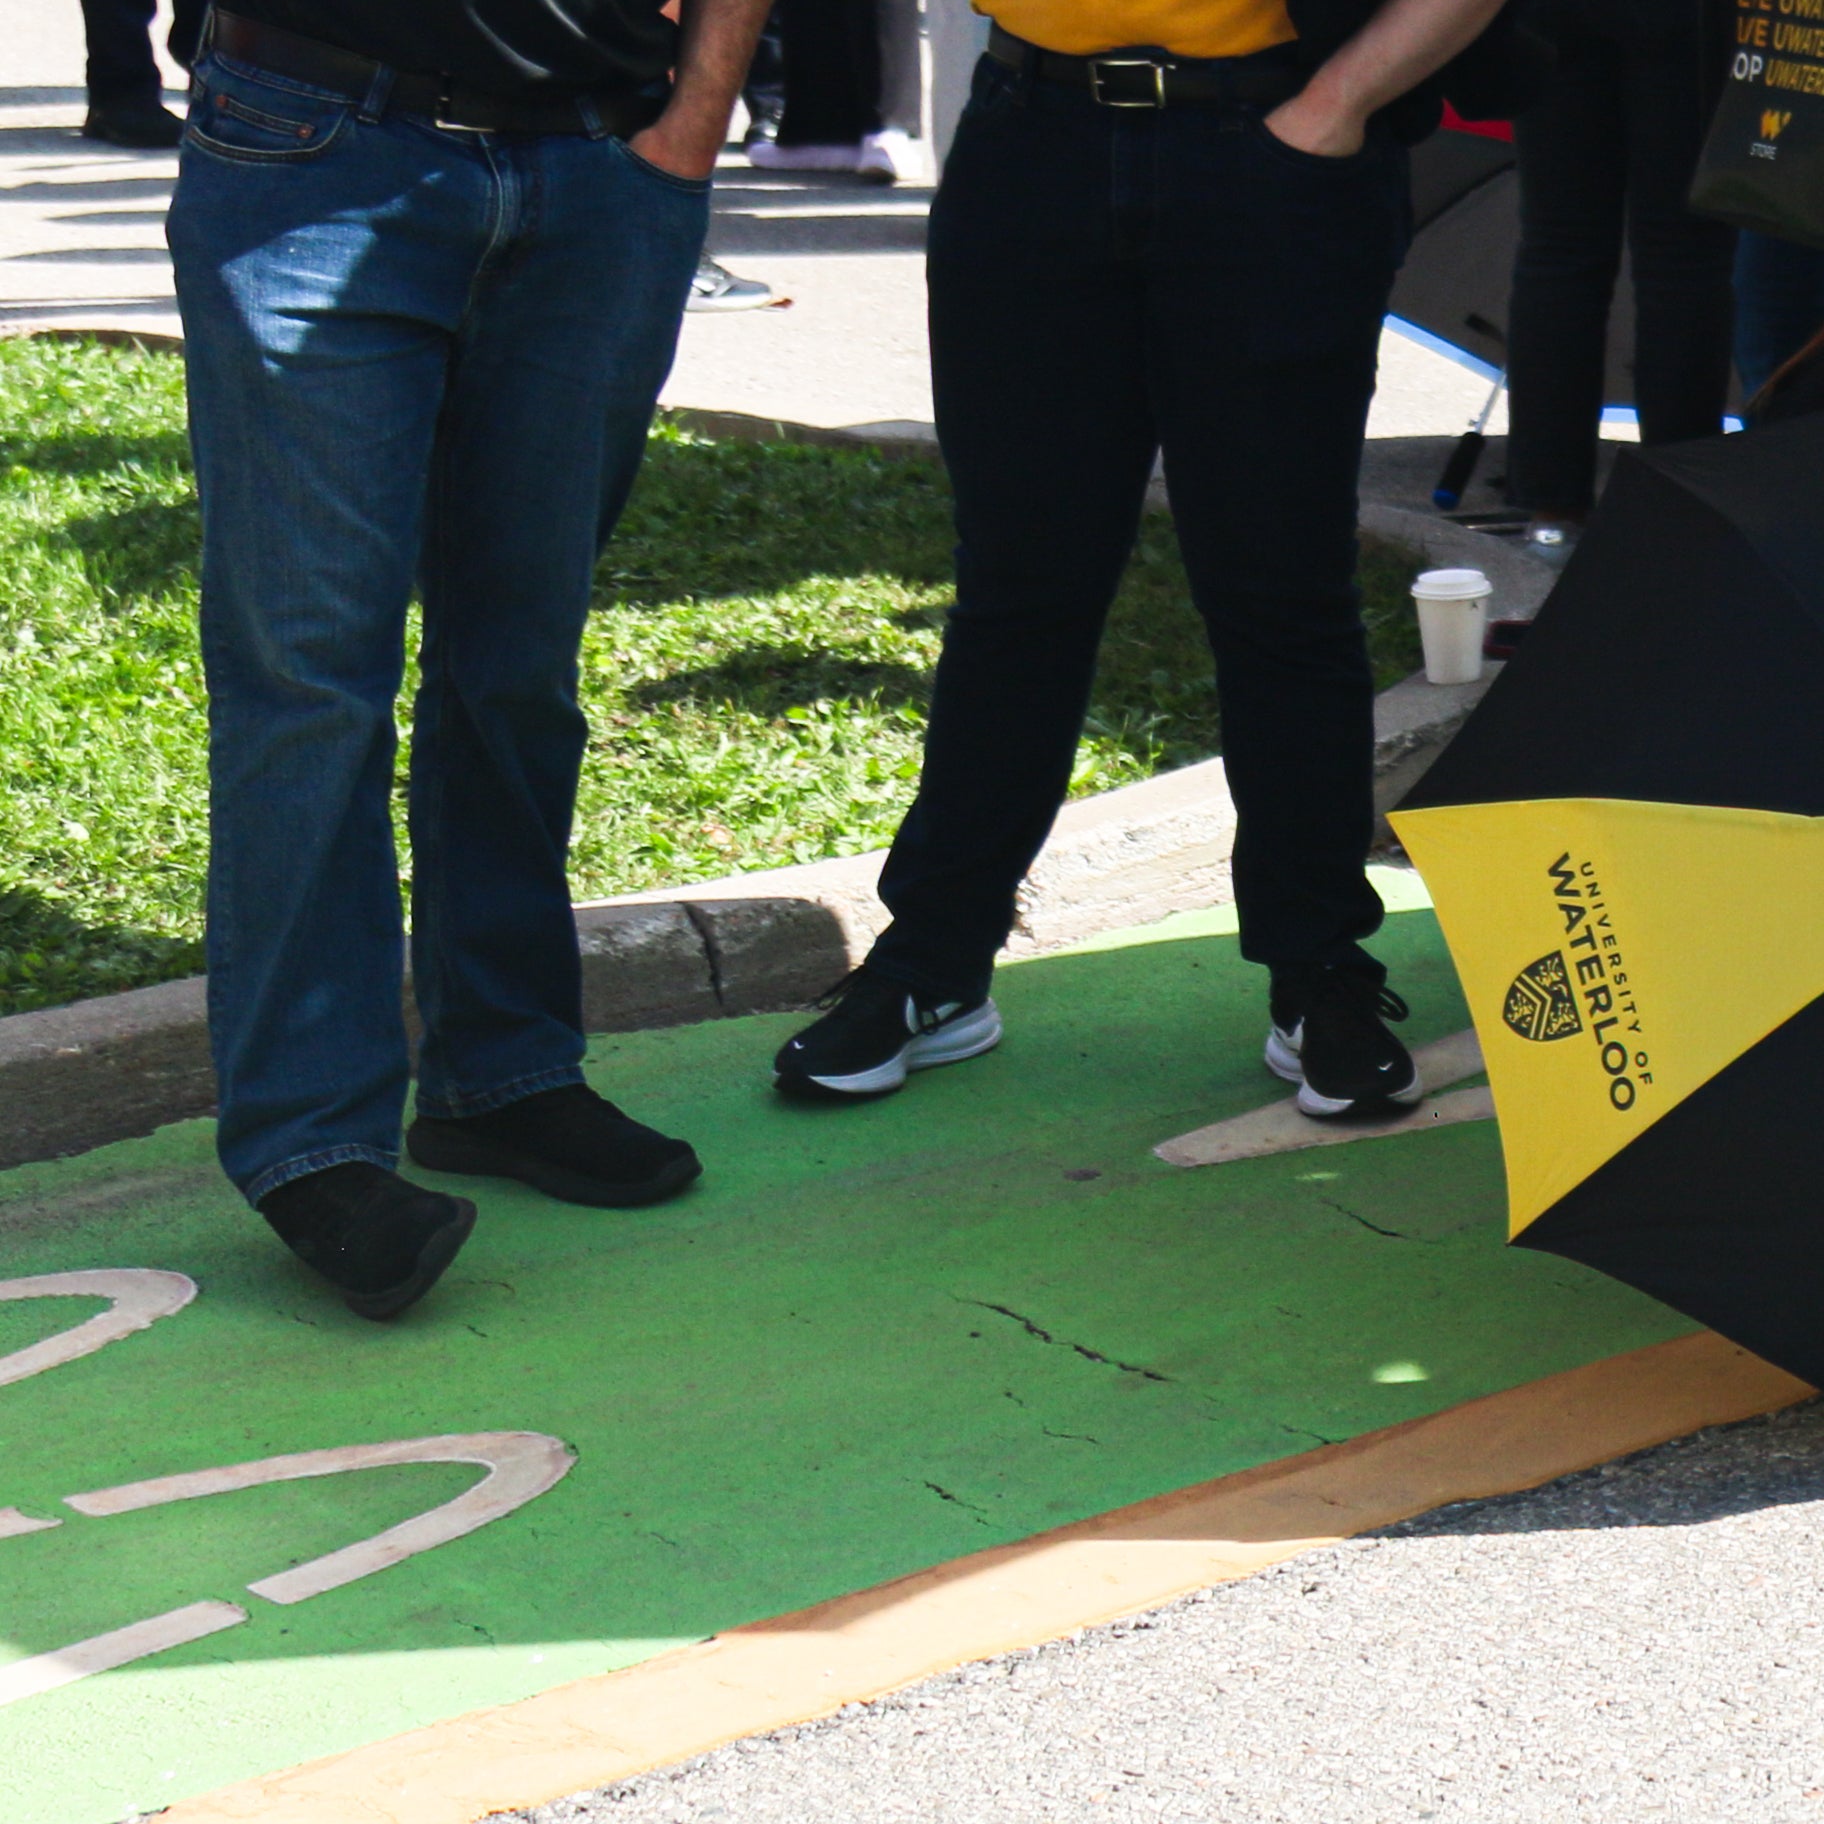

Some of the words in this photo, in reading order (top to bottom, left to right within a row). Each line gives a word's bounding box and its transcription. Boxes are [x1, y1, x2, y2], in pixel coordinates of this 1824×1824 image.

[1547, 851, 1637, 1112] WATERLOO
[1580, 862, 1643, 1034] UNIVERSITY
[1635, 1051, 1654, 1085] OF
